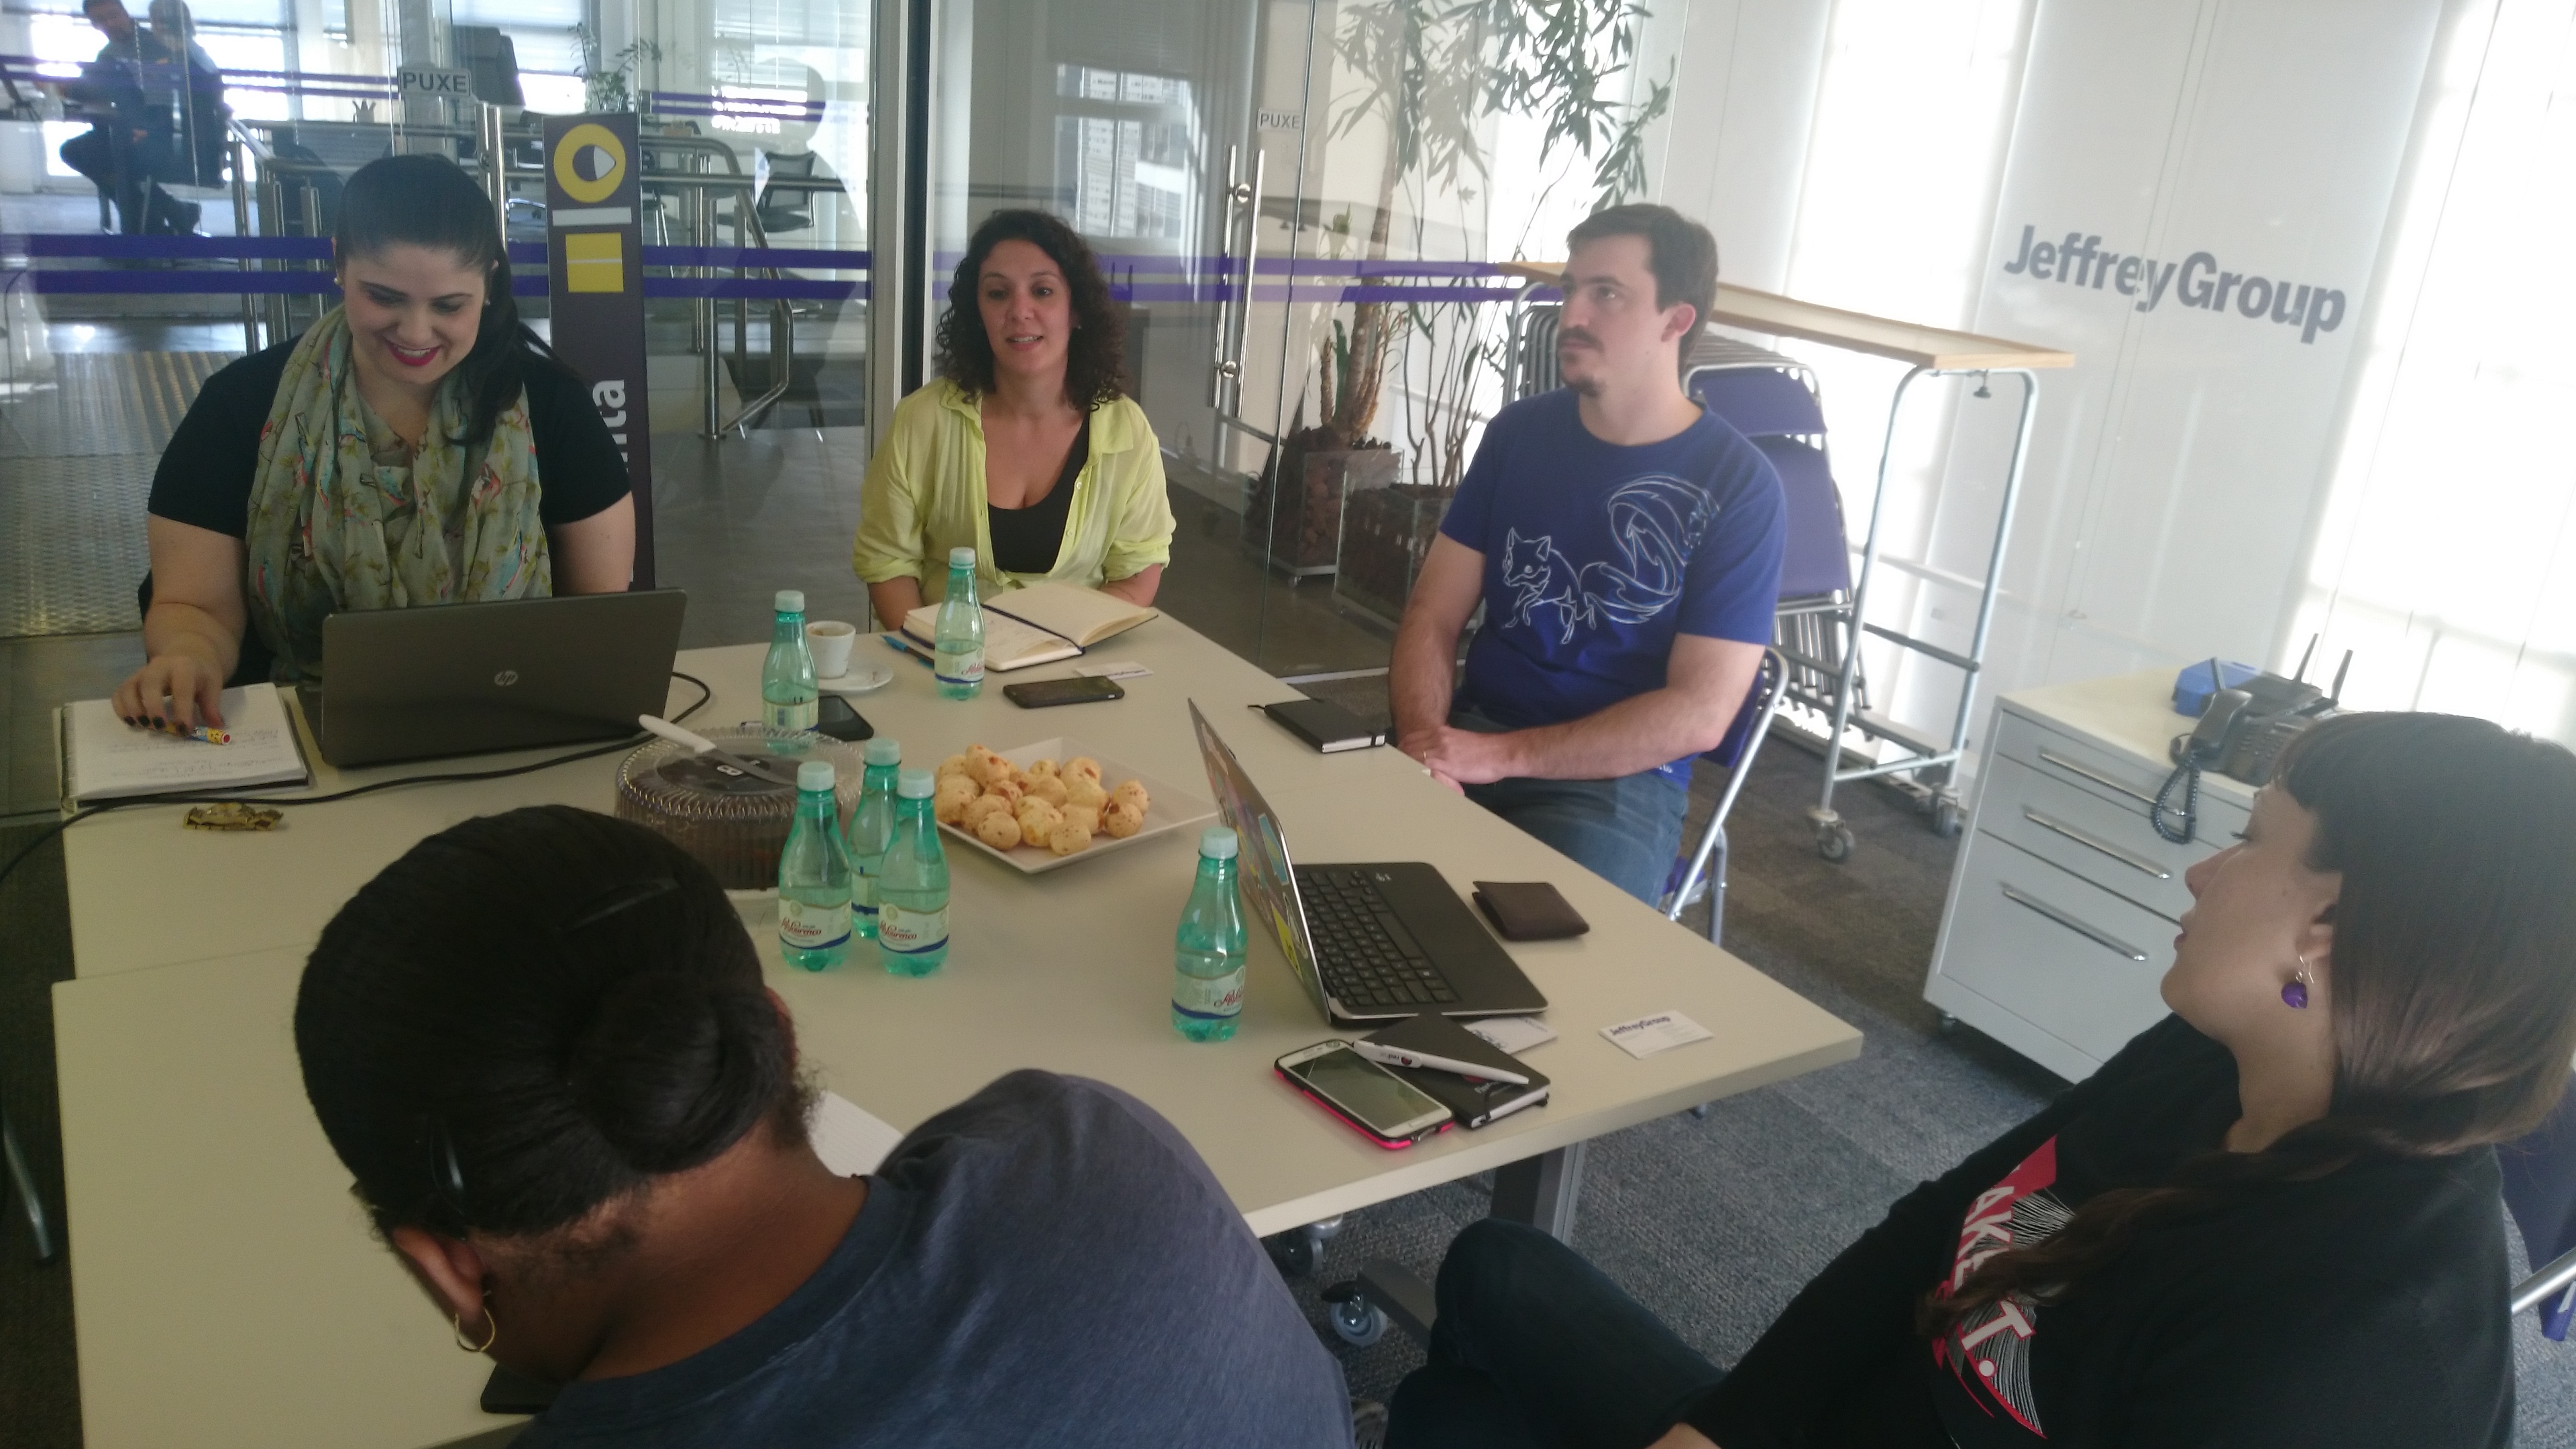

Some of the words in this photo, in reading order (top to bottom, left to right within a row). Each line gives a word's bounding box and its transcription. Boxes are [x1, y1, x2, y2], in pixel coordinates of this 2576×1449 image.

[402, 72, 467, 93] PUXE
[1260, 113, 1301, 129] PUXE
[2003, 224, 2347, 345] JeffreyGroup
[1953, 1165, 2021, 1291] AKE
